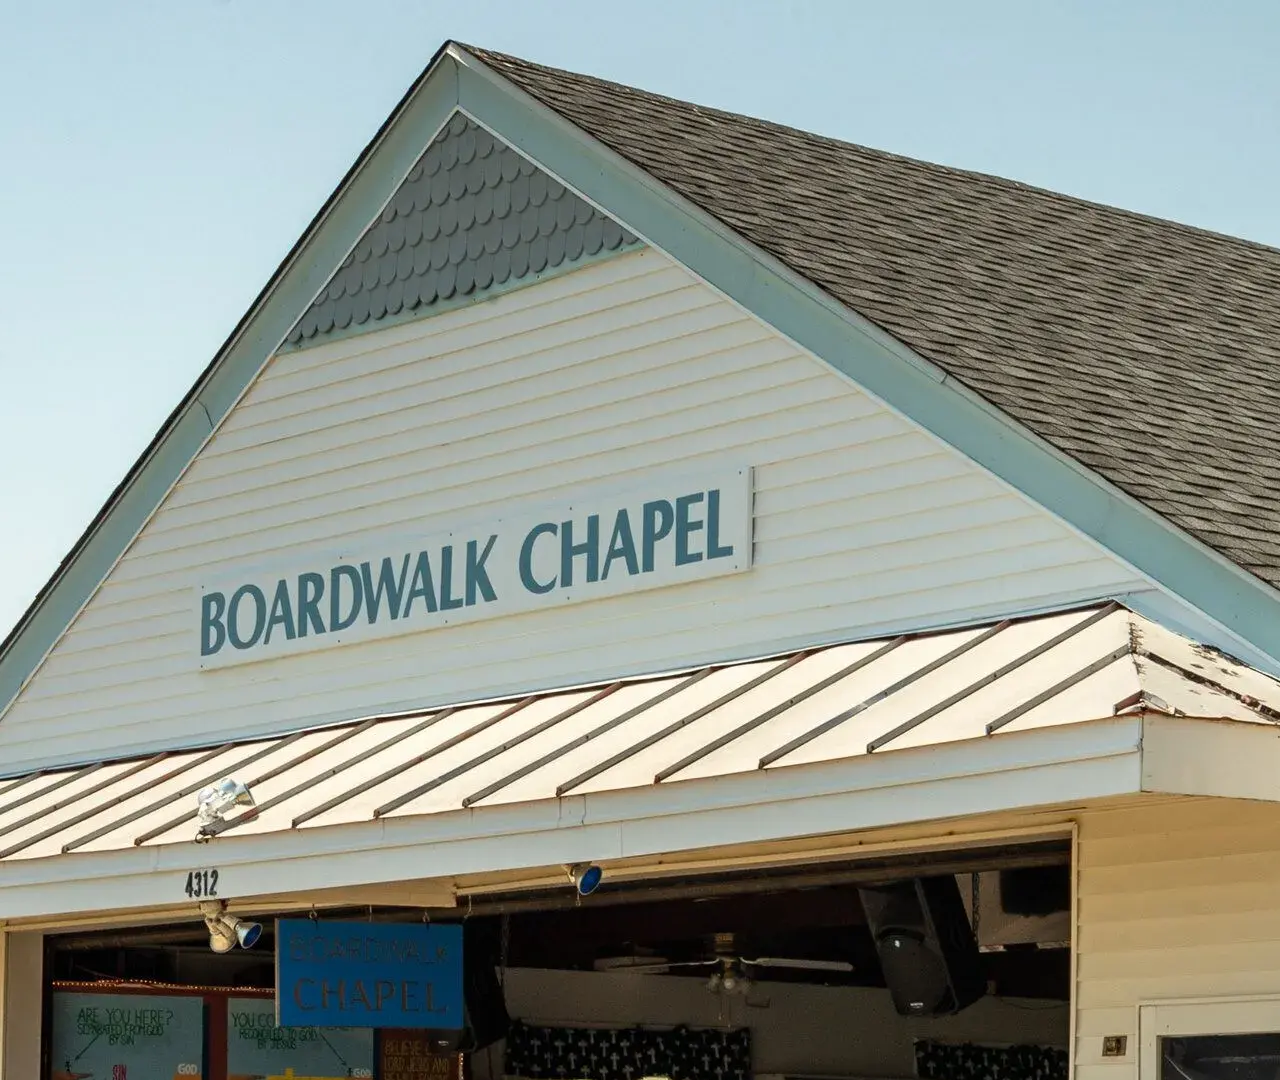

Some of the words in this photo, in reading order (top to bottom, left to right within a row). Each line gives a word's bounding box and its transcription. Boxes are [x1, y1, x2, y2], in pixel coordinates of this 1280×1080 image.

[200, 535, 498, 656] BOARDWALK
[518, 489, 733, 595] CHAPEL
[185, 868, 219, 898] 4312
[293, 978, 448, 1014] CHAPEL
[77, 1008, 99, 1023] ARE
[106, 1008, 131, 1024] YOU
[135, 1010, 173, 1026] HERE?
[232, 1013, 255, 1027] YOU
[177, 1063, 197, 1075] GOD
